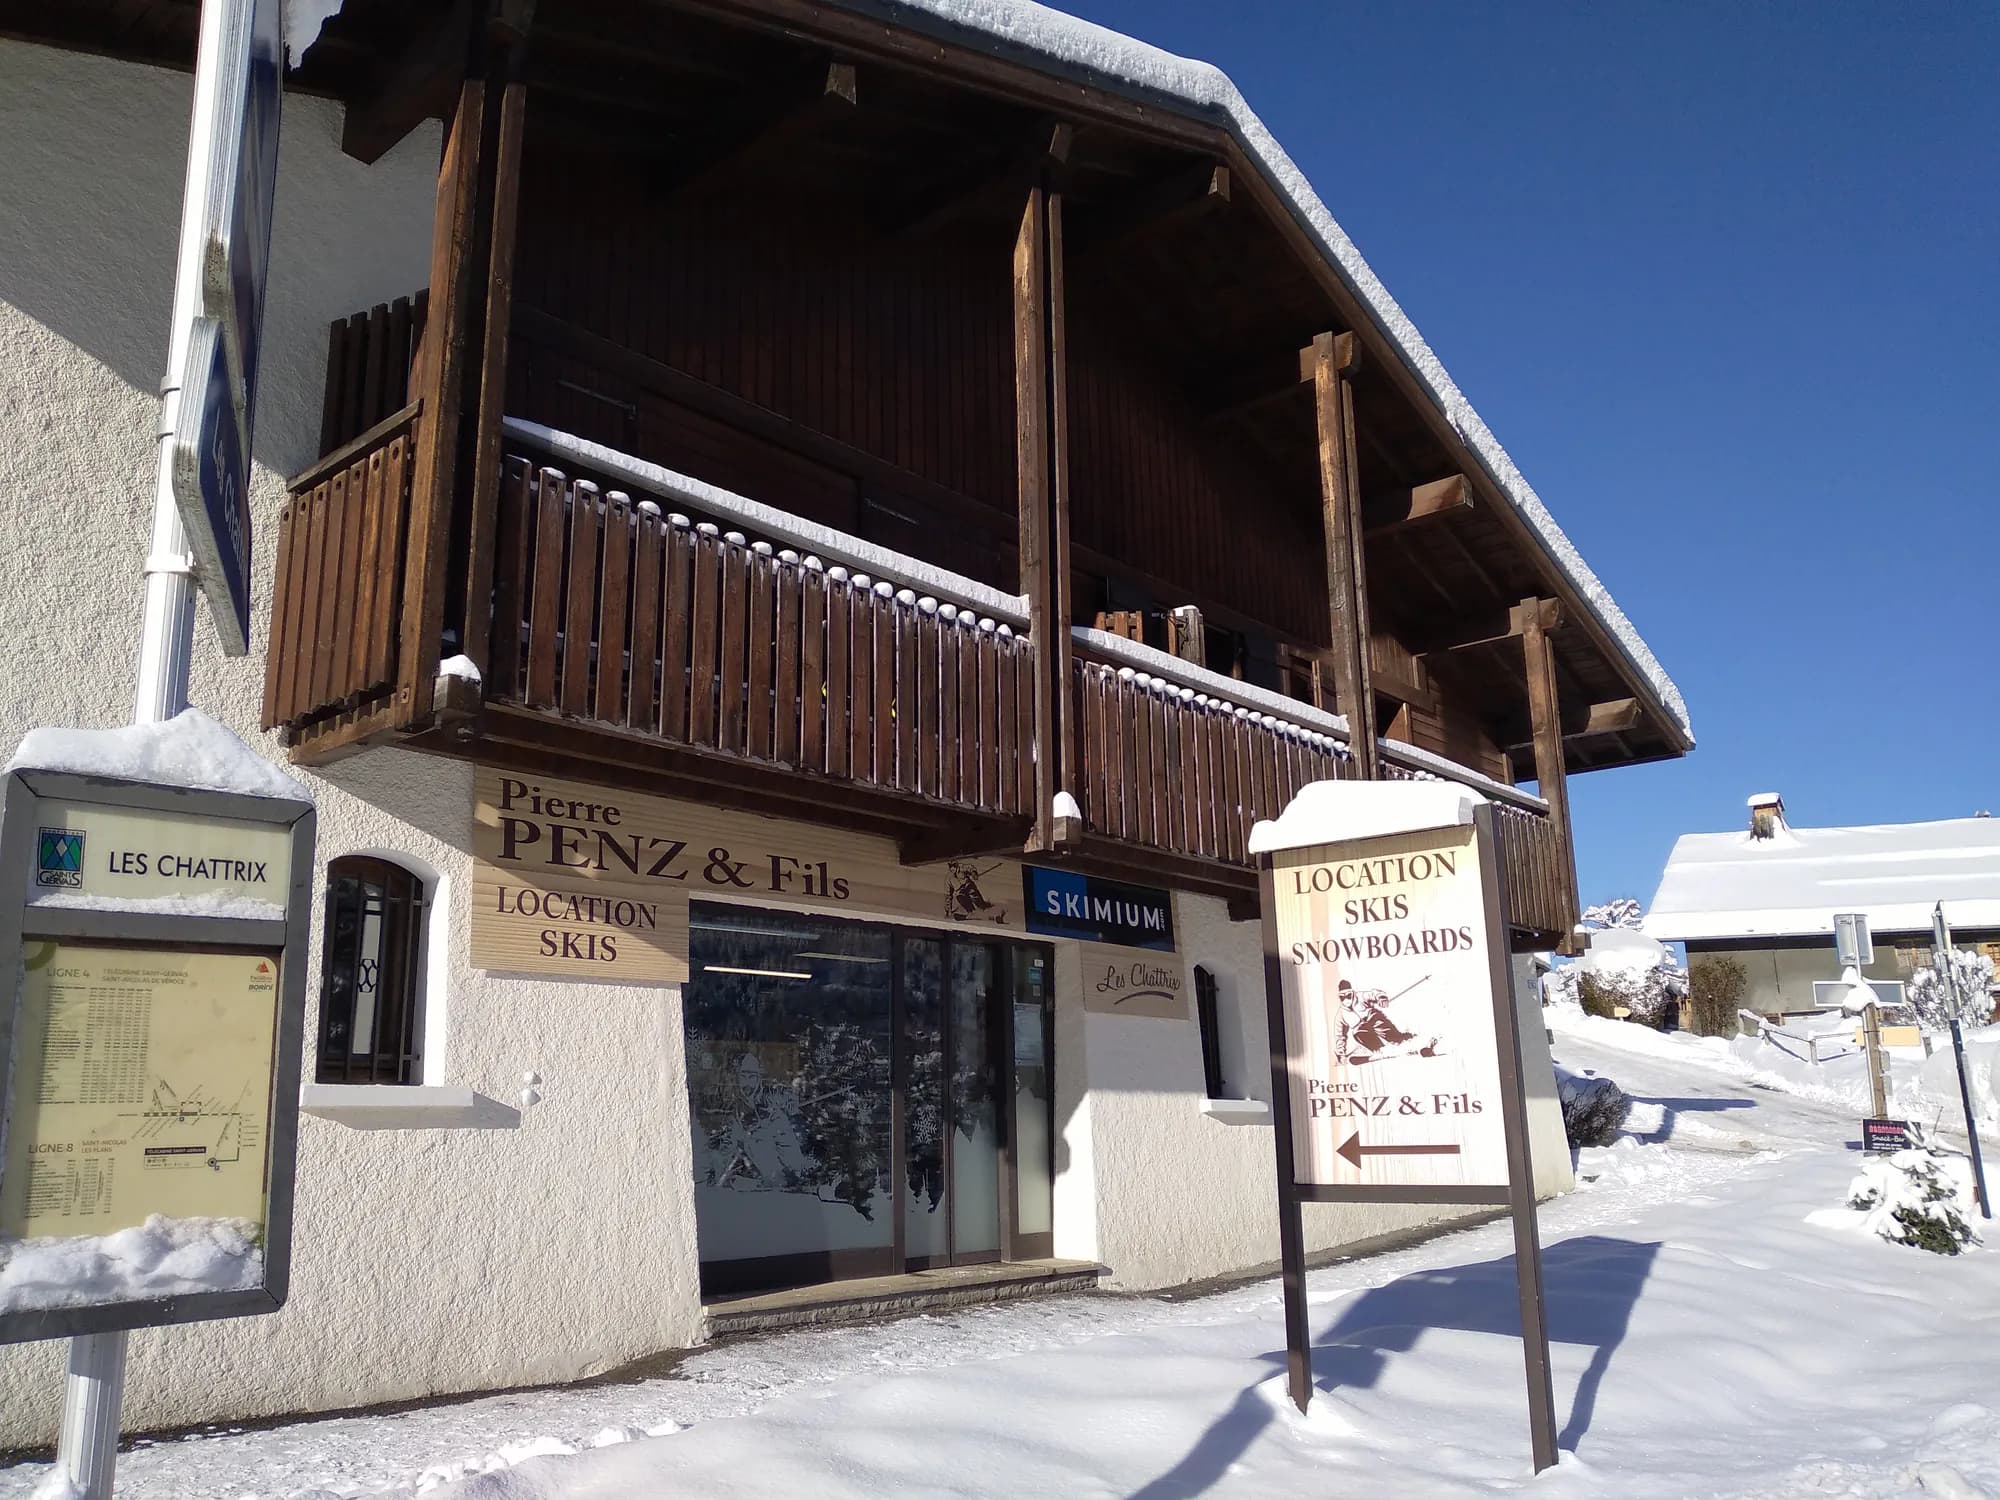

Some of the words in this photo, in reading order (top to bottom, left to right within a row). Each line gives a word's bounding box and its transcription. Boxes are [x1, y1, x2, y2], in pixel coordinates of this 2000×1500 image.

[498, 778, 621, 826] Pierre
[109, 851, 148, 875] LES
[157, 855, 268, 883] CHATTRIX
[497, 816, 688, 881] PENZ
[702, 846, 753, 888] &
[768, 854, 850, 901] Fils
[1294, 851, 1457, 895] LOCATION
[496, 886, 658, 931] LOCATION
[1047, 889, 1160, 931] SKIMIUM
[1344, 894, 1409, 925] SKIS
[540, 931, 618, 963] SKIS
[1292, 926, 1473, 966] SNOWBOARDS
[47, 968, 80, 977] LIGNE
[83, 969, 90, 978] 4
[1096, 965, 1125, 992] Les
[1131, 963, 1181, 991] Chattrix
[1308, 1078, 1358, 1094] Pierre
[1310, 1095, 1391, 1119] PENZ
[1399, 1096, 1424, 1116] &
[1433, 1093, 1482, 1116] Fils
[28, 1144, 63, 1153] LIGNE
[66, 1143, 74, 1152] 8
